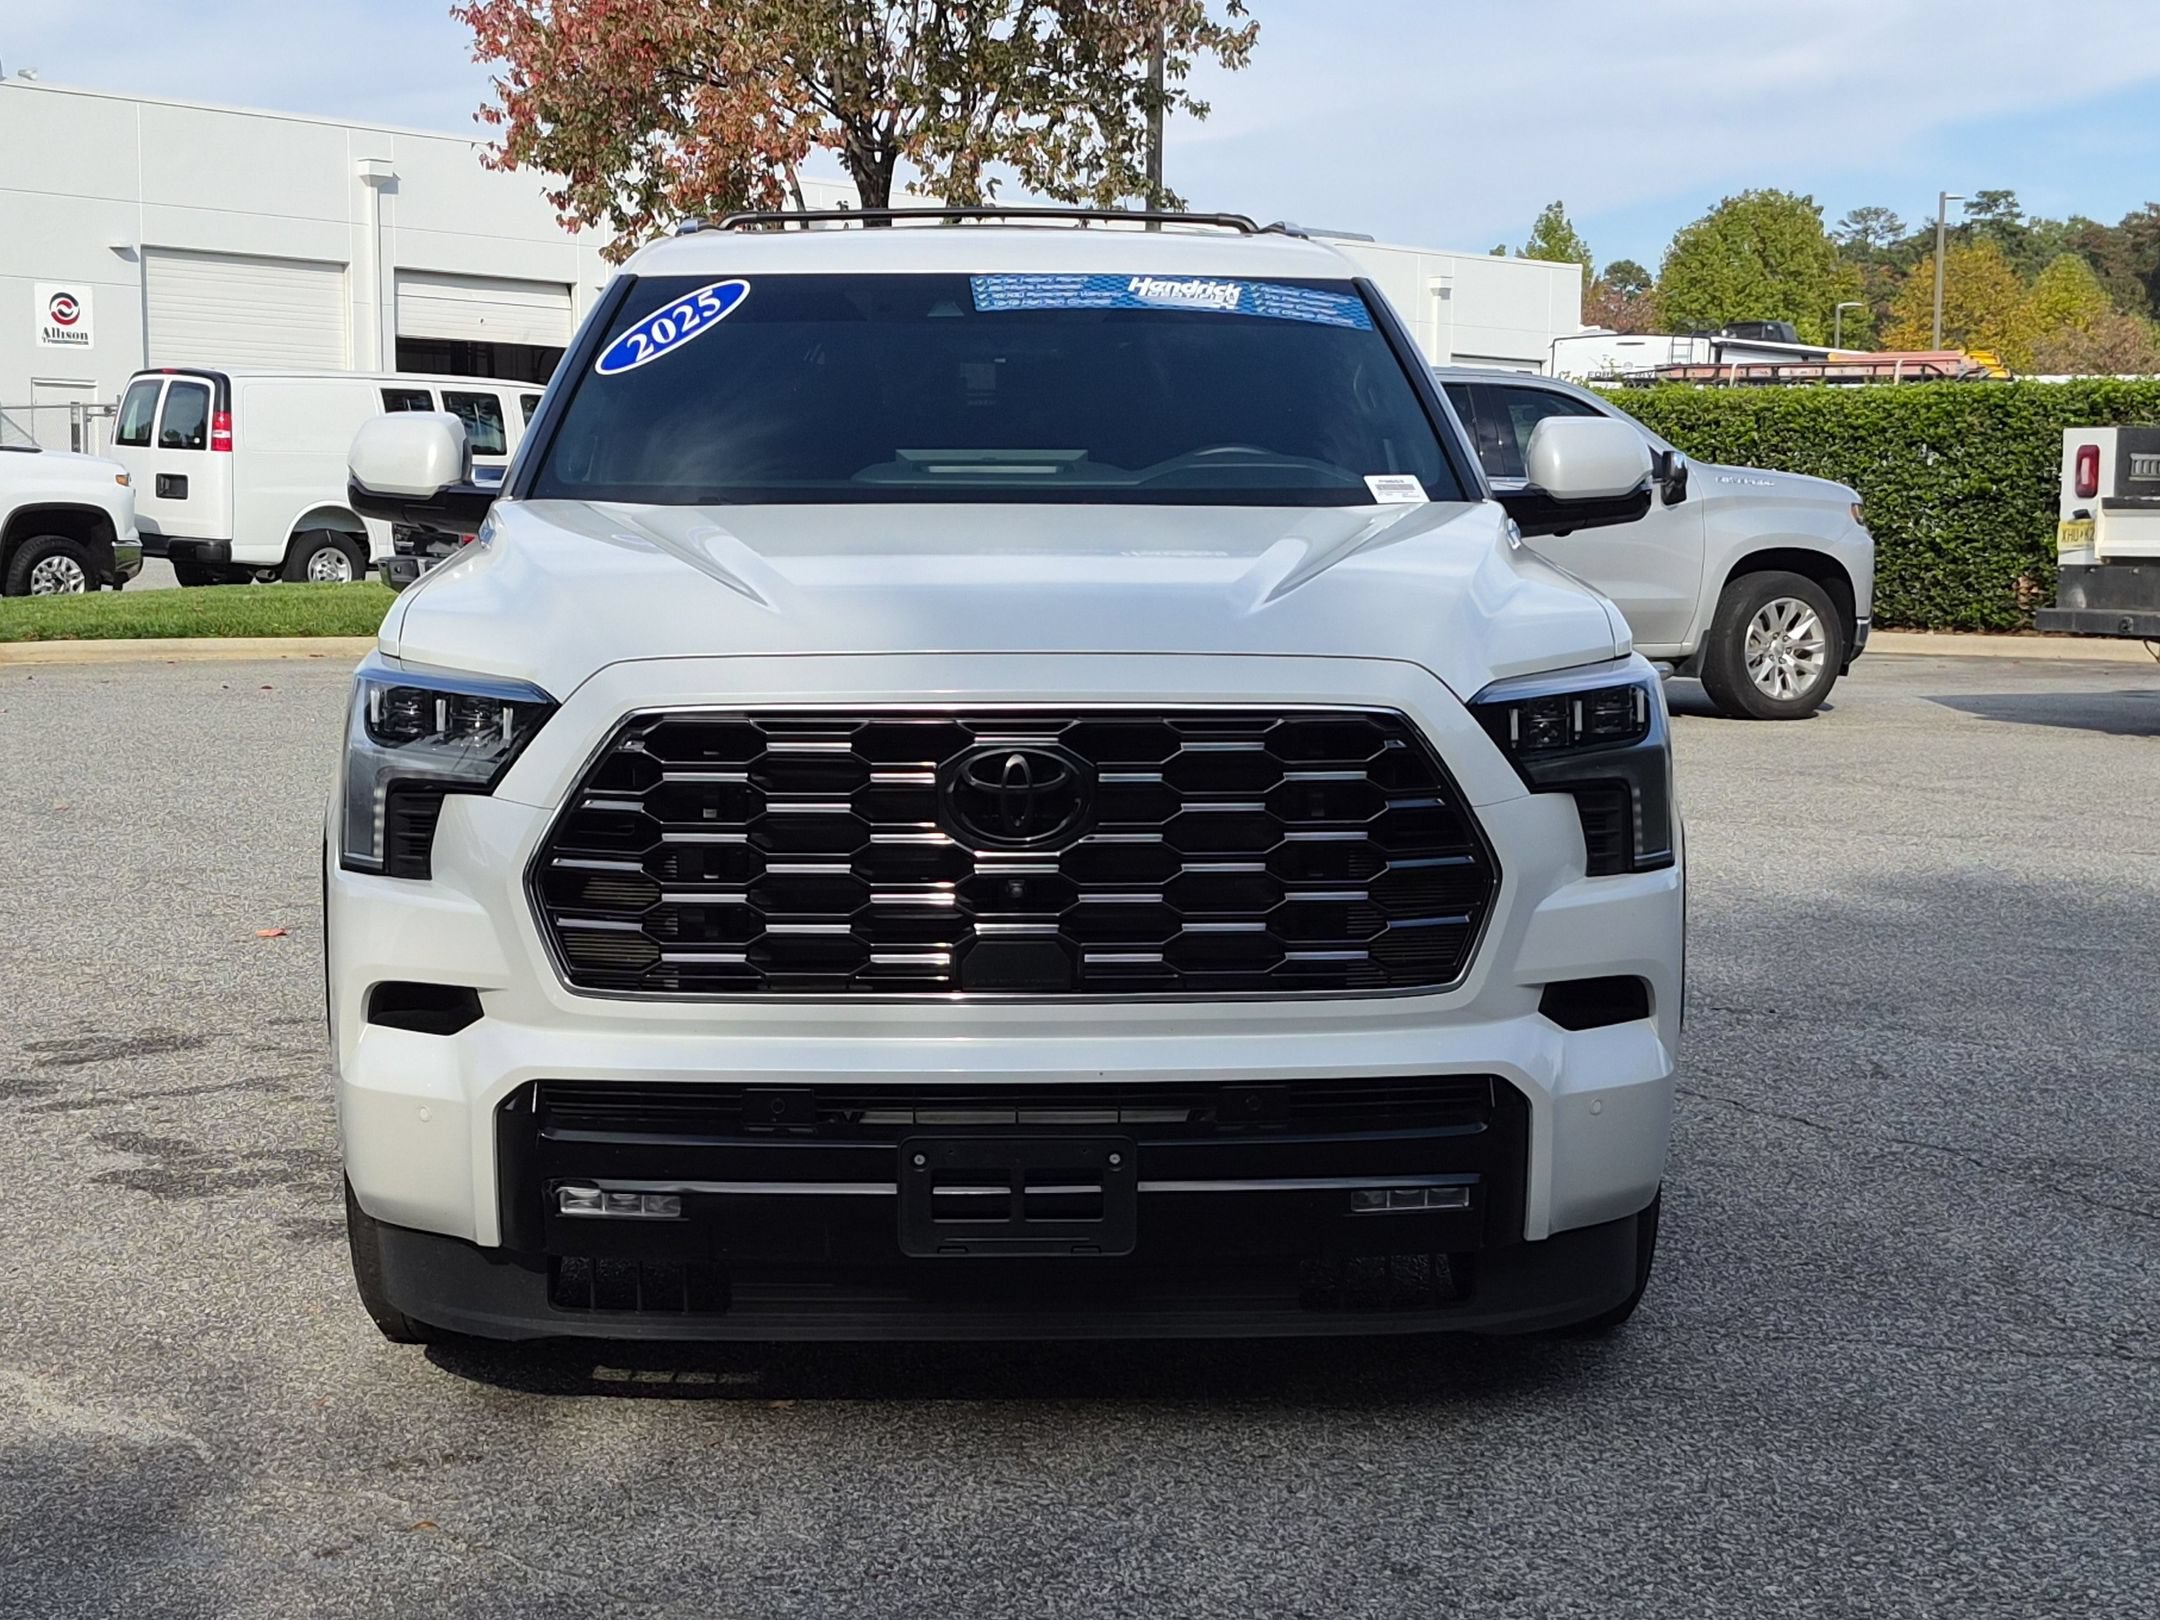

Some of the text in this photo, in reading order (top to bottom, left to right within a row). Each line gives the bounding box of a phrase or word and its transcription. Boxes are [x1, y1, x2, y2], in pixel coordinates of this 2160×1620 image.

[1128, 277, 1242, 301] Hendrick
[42, 326, 88, 340] Allison
[627, 289, 721, 362] 2025
